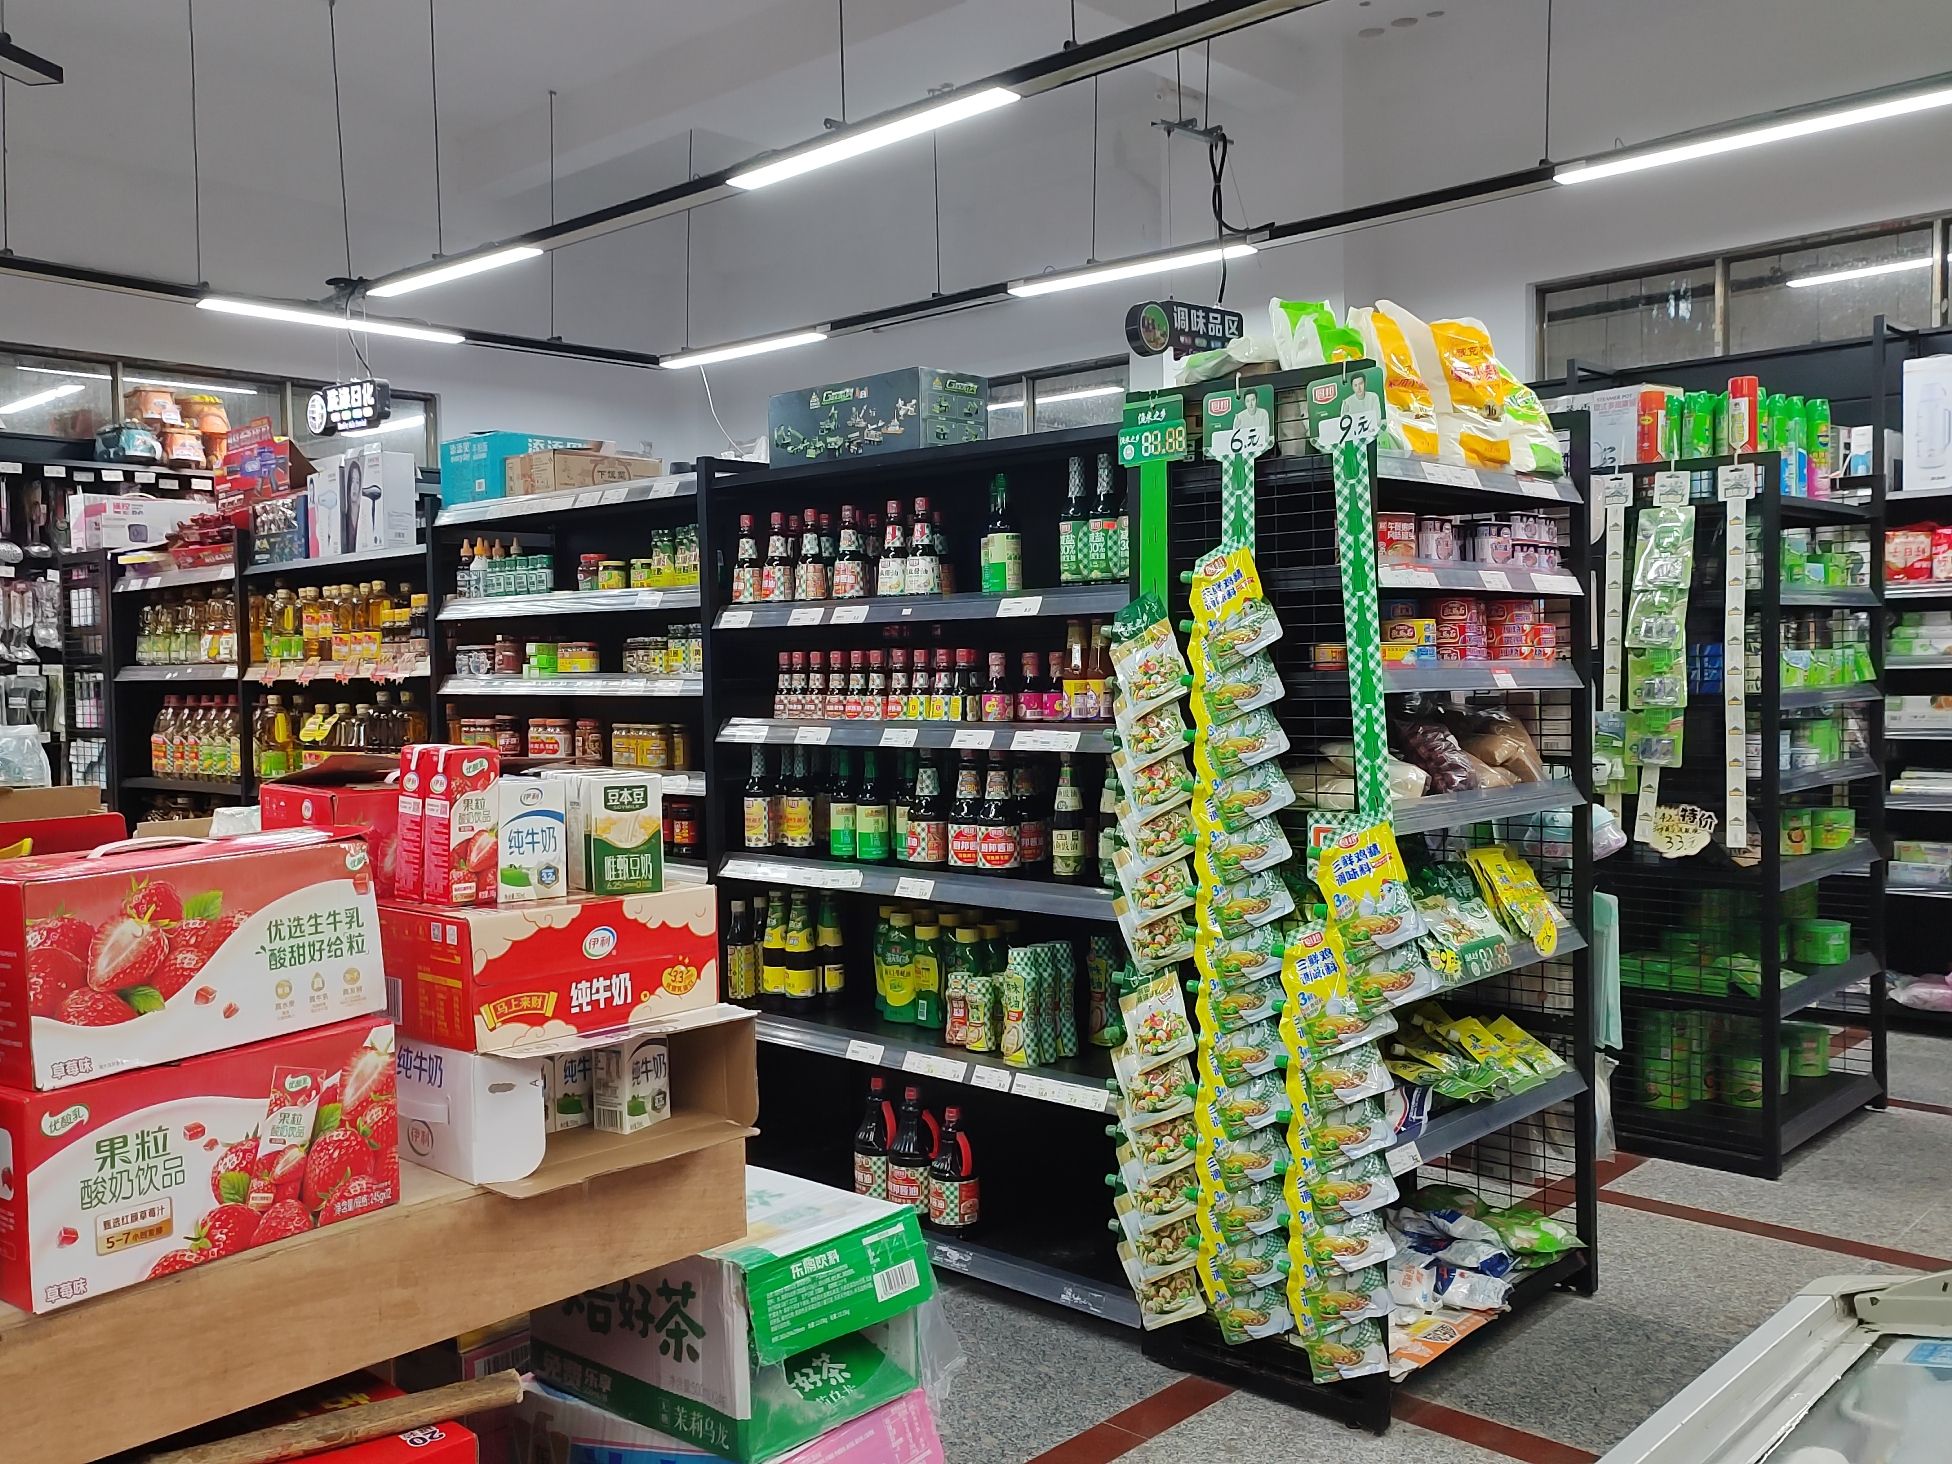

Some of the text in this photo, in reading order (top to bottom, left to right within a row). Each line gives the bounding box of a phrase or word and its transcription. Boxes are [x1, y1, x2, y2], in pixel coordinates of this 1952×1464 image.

[1173, 306, 1239, 338] 调味品区
[606, 788, 646, 806] 豆本豆
[1680, 807, 1715, 831] 特价
[508, 826, 557, 855] 纯牛奶
[604, 854, 653, 881] 唯甄豆奶
[267, 906, 365, 944] 优选生牛乳
[589, 936, 611, 950] 伊利
[495, 997, 544, 1015] 马上来财
[571, 972, 632, 1014] 纯牛奶
[51, 1056, 94, 1080] 草莓味
[396, 1045, 443, 1088] 纯牛奶
[631, 1053, 667, 1087] 纯牛奶
[49, 1107, 85, 1133] 优酸乳
[278, 1112, 304, 1126] 果粒
[95, 1125, 171, 1173] 果粒
[410, 1126, 431, 1148] 伊利
[80, 1156, 186, 1211] 酸奶饮品
[45, 1277, 88, 1304] 草莓味
[673, 1404, 730, 1451] 茉莉乌龙
